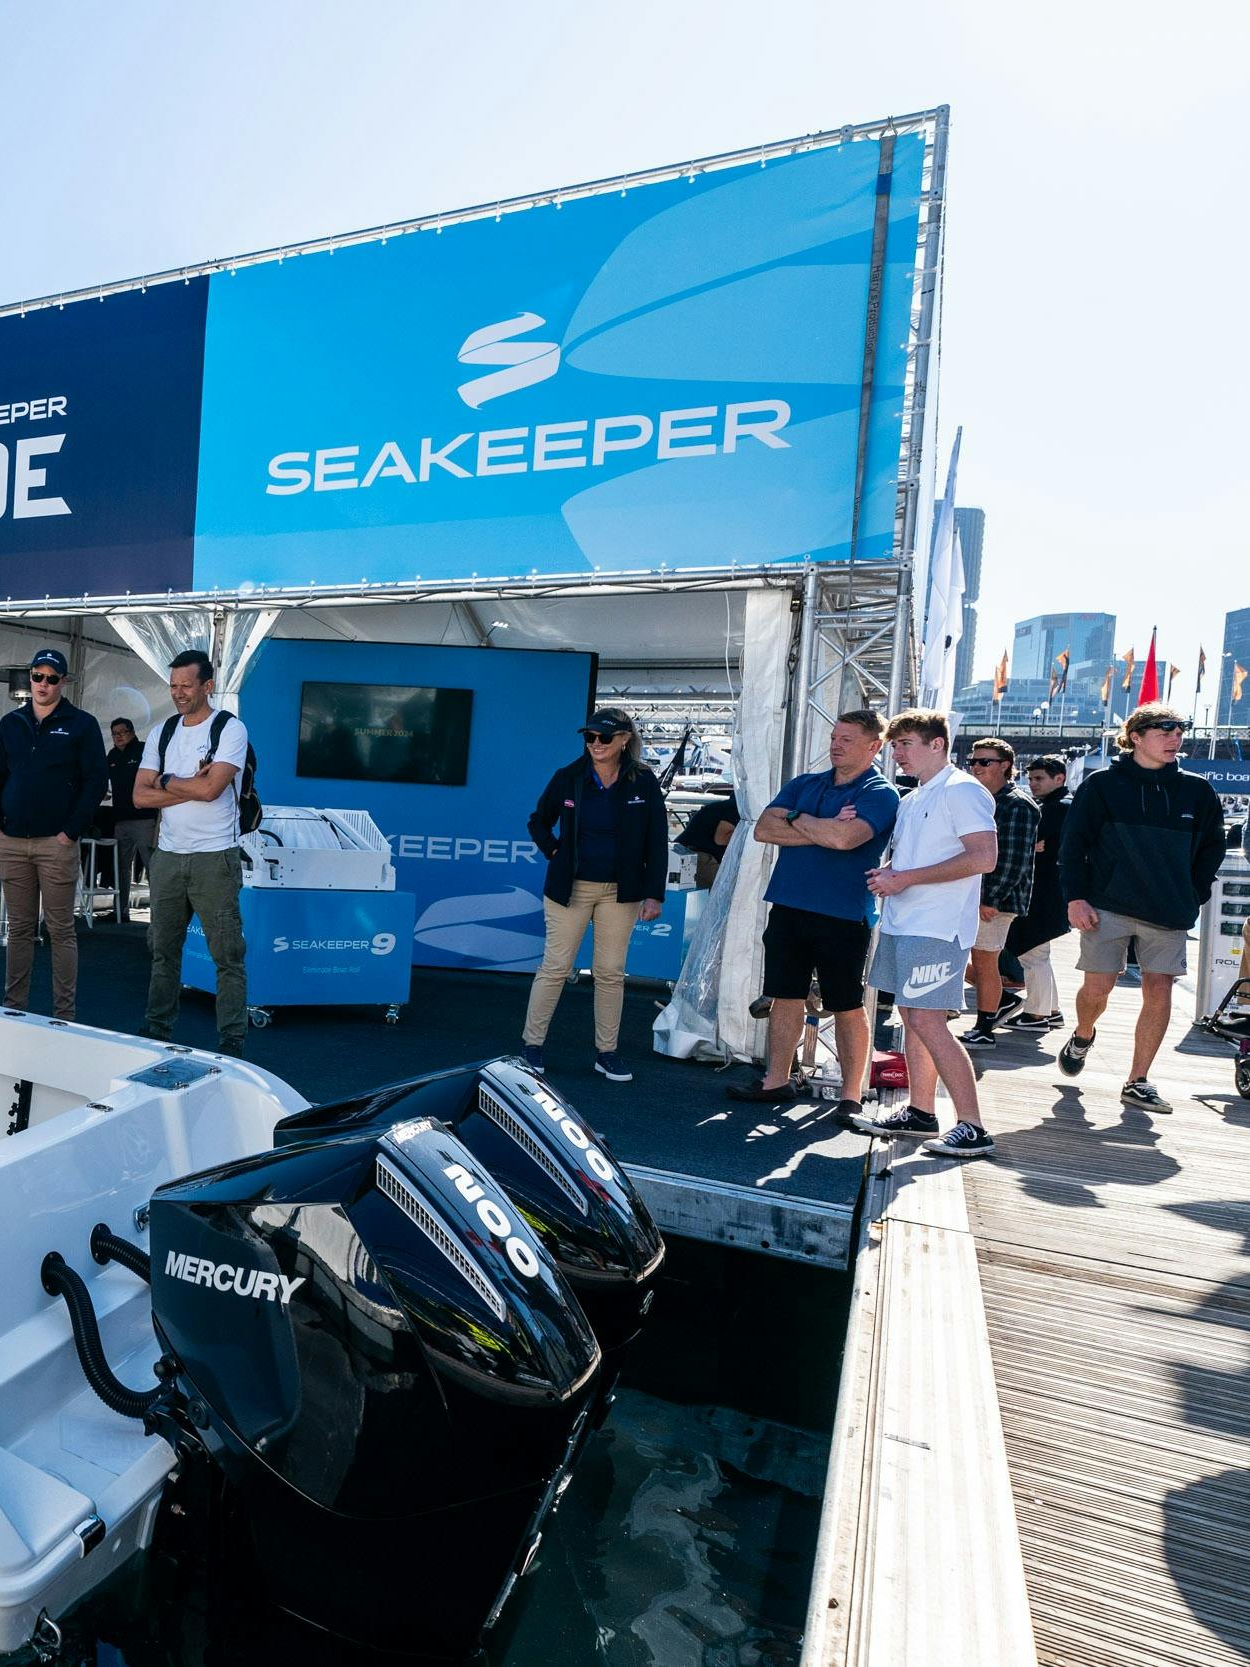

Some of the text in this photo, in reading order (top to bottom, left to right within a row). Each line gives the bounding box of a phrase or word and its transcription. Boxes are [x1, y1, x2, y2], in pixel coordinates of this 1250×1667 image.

[265, 399, 792, 495] SEAKEEPER
[651, 924, 672, 937] 2
[292, 932, 396, 955] SEAKEEPER 9
[910, 961, 952, 985] NIKE
[165, 1251, 306, 1304] MERCURY
